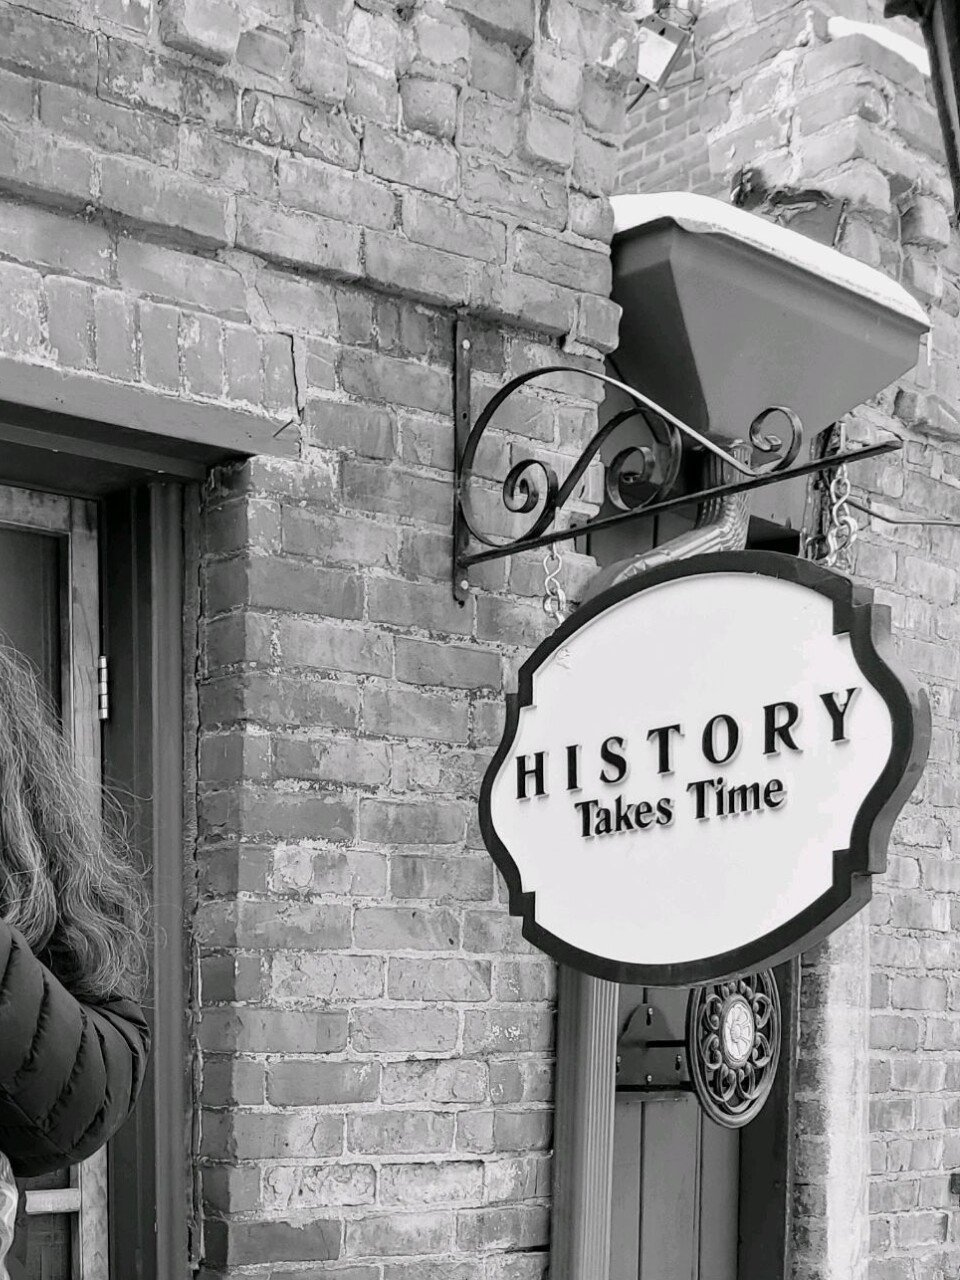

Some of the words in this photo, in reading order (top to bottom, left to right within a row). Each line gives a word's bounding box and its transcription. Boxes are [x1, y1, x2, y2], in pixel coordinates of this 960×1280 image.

[515, 687, 862, 800] HISTORY
[574, 793, 675, 839] Takes
[686, 776, 787, 821] Time
